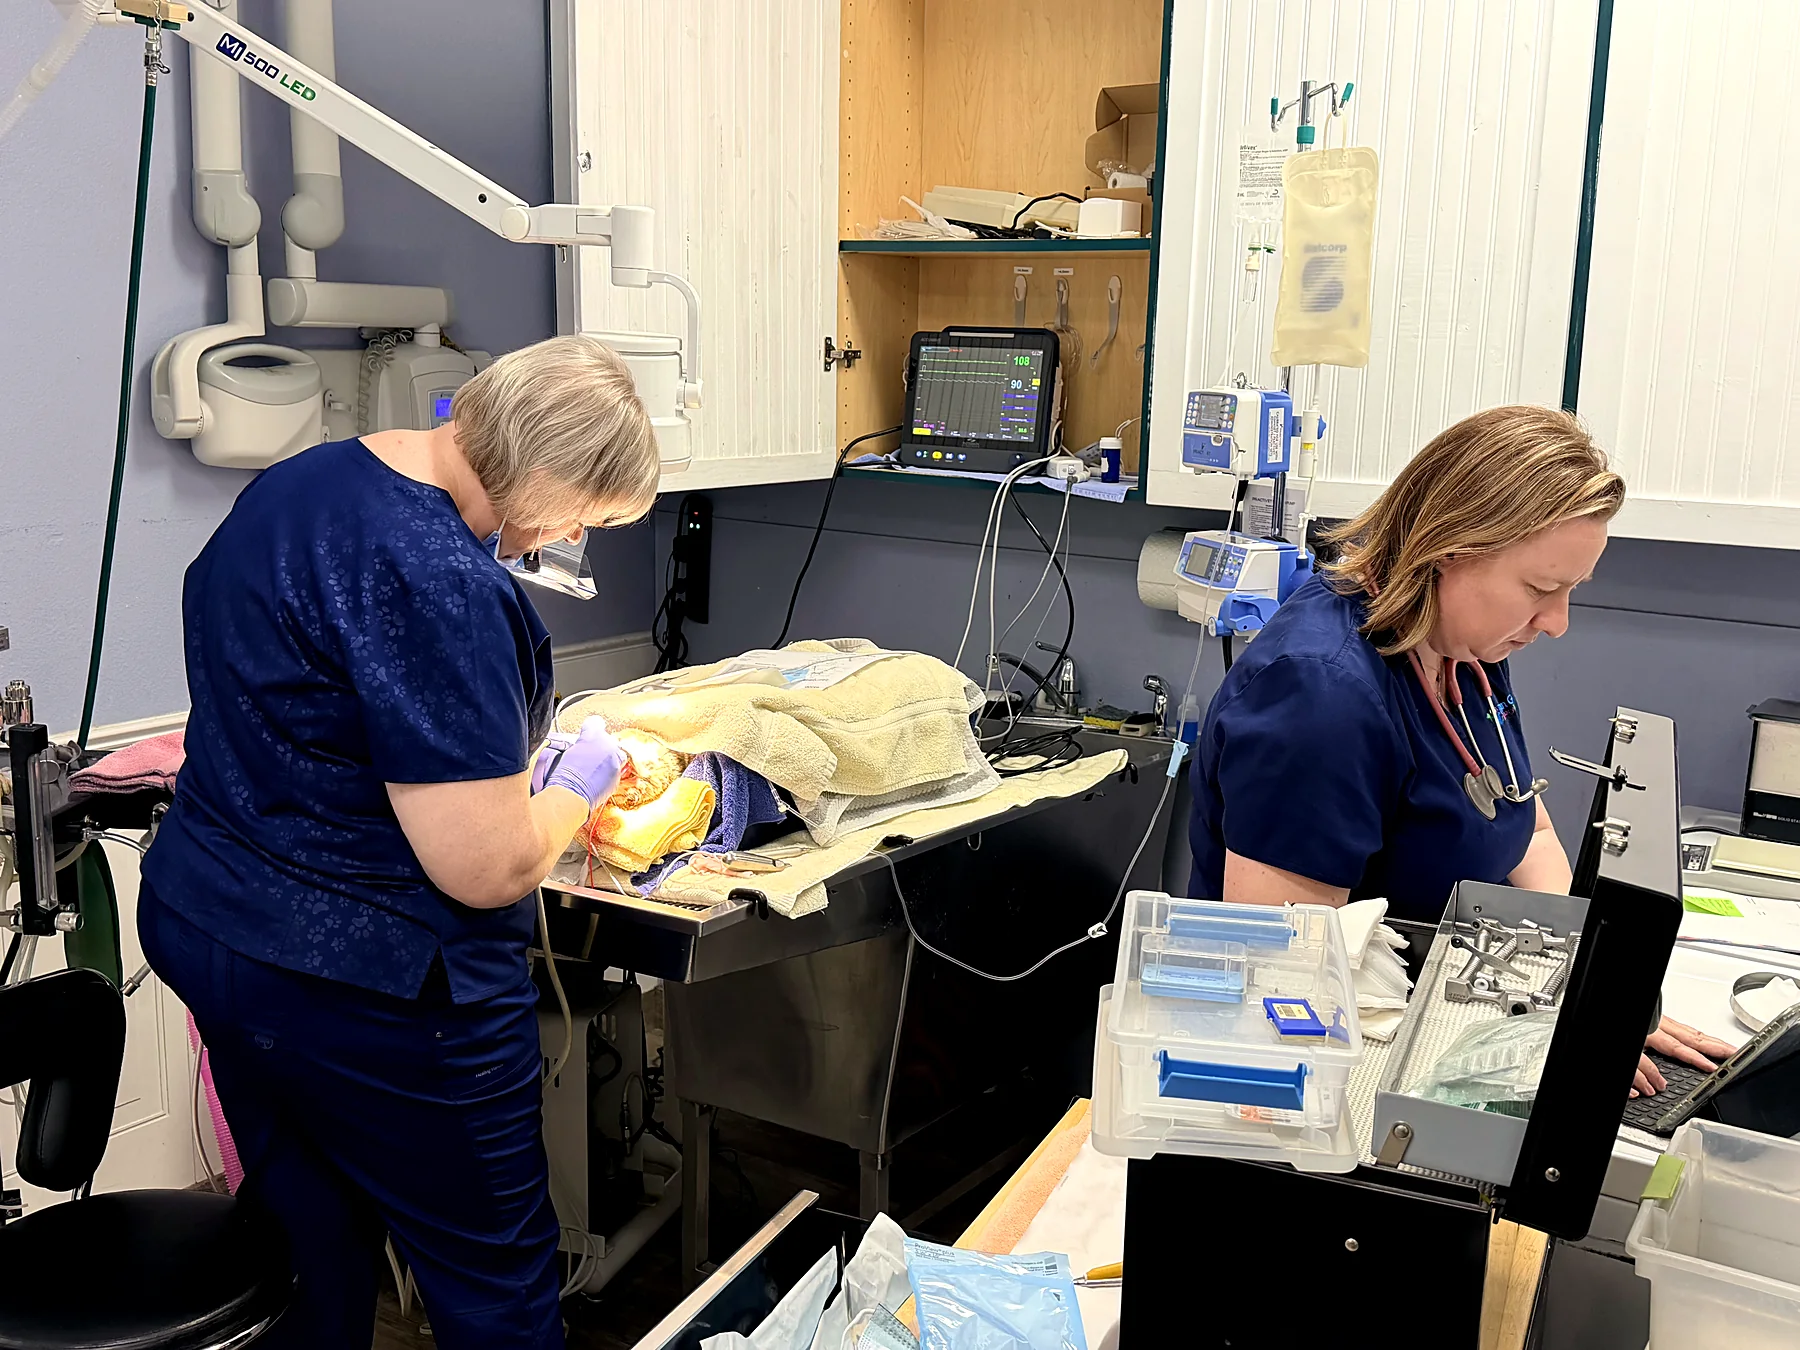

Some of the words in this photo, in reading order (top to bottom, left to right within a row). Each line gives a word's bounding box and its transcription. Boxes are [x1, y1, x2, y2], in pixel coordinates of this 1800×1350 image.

[243, 51, 280, 79] 500
[279, 73, 317, 101] LED
[1013, 356, 1030, 366] 108
[1010, 379, 1022, 389] 90
